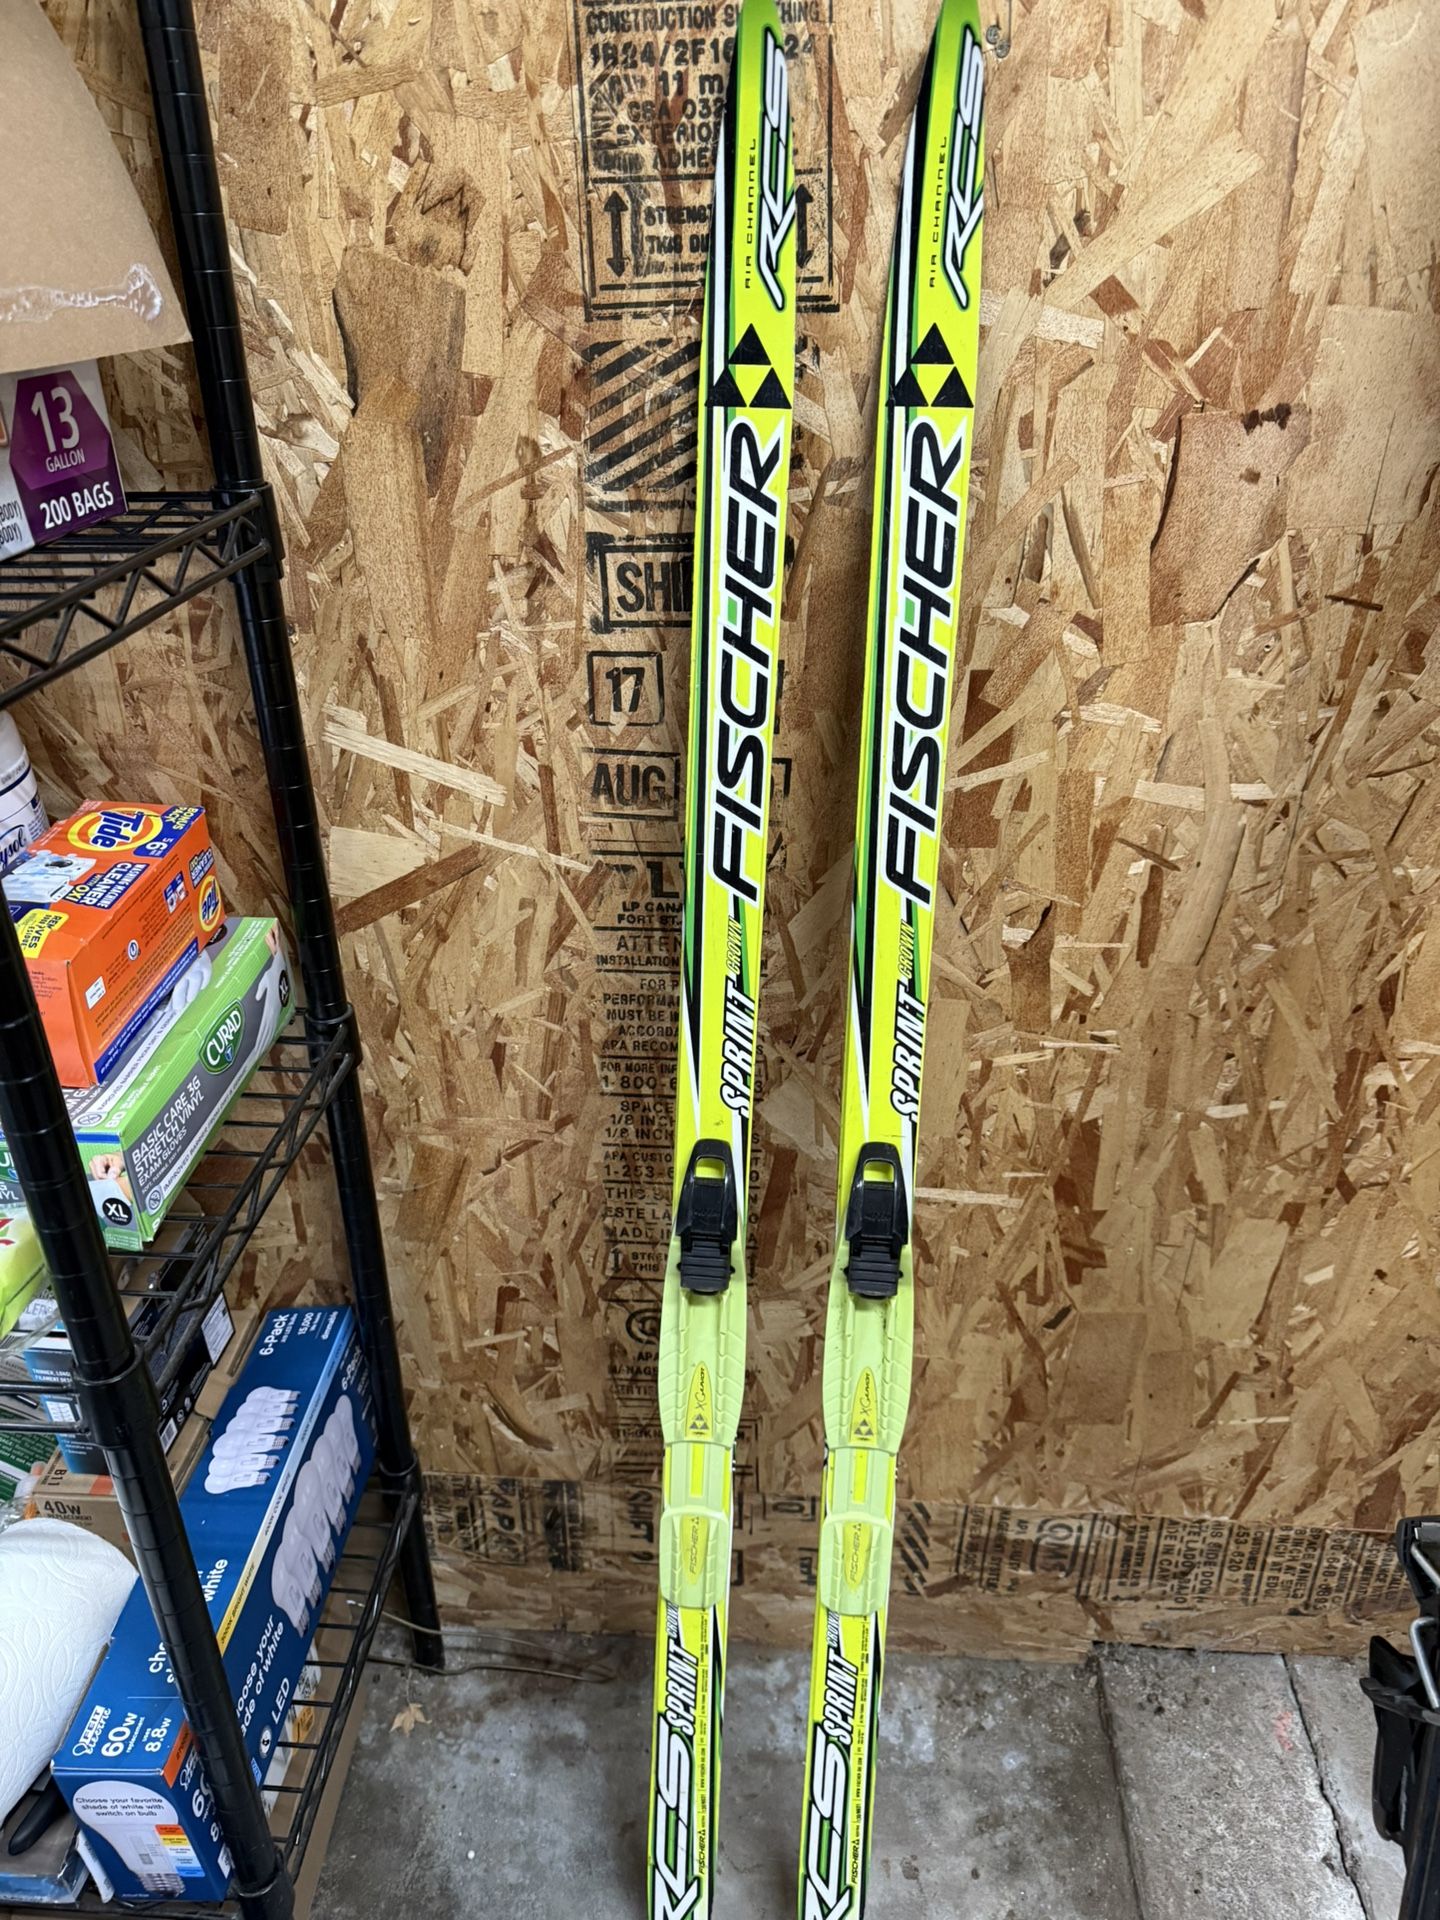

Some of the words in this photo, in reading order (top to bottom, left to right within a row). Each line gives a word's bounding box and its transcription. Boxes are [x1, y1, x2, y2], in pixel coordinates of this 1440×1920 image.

[699, 73, 725, 95] m
[747, 138, 758, 247] CHANNEL
[928, 254, 939, 290] AIR
[934, 136, 948, 246] CHANNEL
[744, 255, 754, 290] AIR
[31, 386, 81, 454] 13
[45, 448, 86, 473] GALLON
[40, 496, 72, 530] 200
[71, 481, 115, 518] BAGS
[616, 560, 693, 612] SHI
[710, 420, 782, 903] FISCHER
[885, 422, 963, 907] FISCHER
[606, 666, 646, 712] 17
[0, 828, 26, 872] ysol
[87, 809, 146, 850] Tide
[65, 887, 89, 901] OXI
[79, 865, 131, 903] CLEANER
[596, 954, 680, 967] INSTALLATION
[616, 934, 682, 953] ATTEN
[726, 915, 743, 976] CROWN
[897, 919, 916, 980] CROWN
[206, 1009, 243, 1067] CURAD
[606, 1010, 643, 1023] MUST
[720, 976, 756, 1118] SPRINT
[889, 979, 926, 1120] SPRINT
[131, 1123, 165, 1164] BASIC
[164, 1096, 191, 1125] CARE
[187, 1076, 202, 1098] 3G
[620, 1101, 674, 1114] SPACE
[134, 1120, 180, 1175] STRETCH
[177, 1093, 205, 1126] VINYL
[138, 1158, 163, 1188] EXAM
[162, 1126, 188, 1161] GLOVES
[106, 1202, 130, 1219] XL
[258, 1313, 290, 1355] 6-Pack
[203, 1558, 229, 1602] white
[256, 1614, 274, 1660] your
[262, 1621, 284, 1673] white
[271, 1676, 290, 1725] LED
[665, 1641, 699, 1738] SPRINT
[821, 1650, 859, 1746] SPRINT
[83, 1709, 100, 1739] FEIT
[110, 1797, 130, 1806] your
[130, 1796, 163, 1804] favorite
